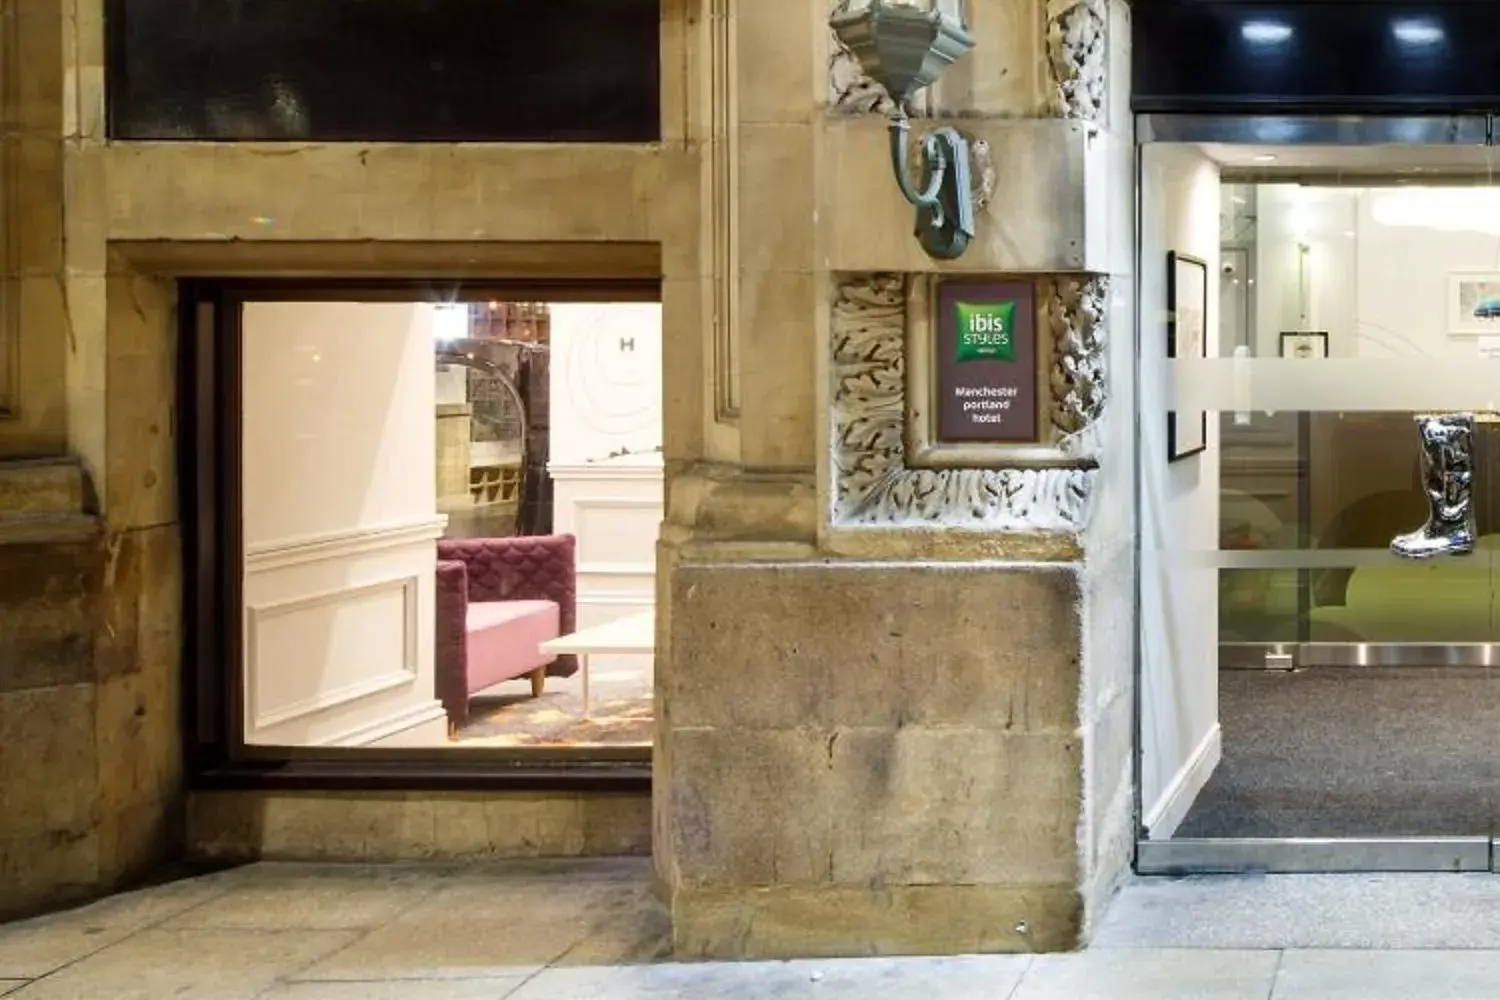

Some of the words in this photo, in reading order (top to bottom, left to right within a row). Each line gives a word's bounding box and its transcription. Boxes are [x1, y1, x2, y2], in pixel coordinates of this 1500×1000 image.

[969, 313, 1003, 332] ibis
[955, 386, 1018, 397] Manchester
[963, 400, 1010, 411] portland
[972, 414, 1001, 423] hotel
